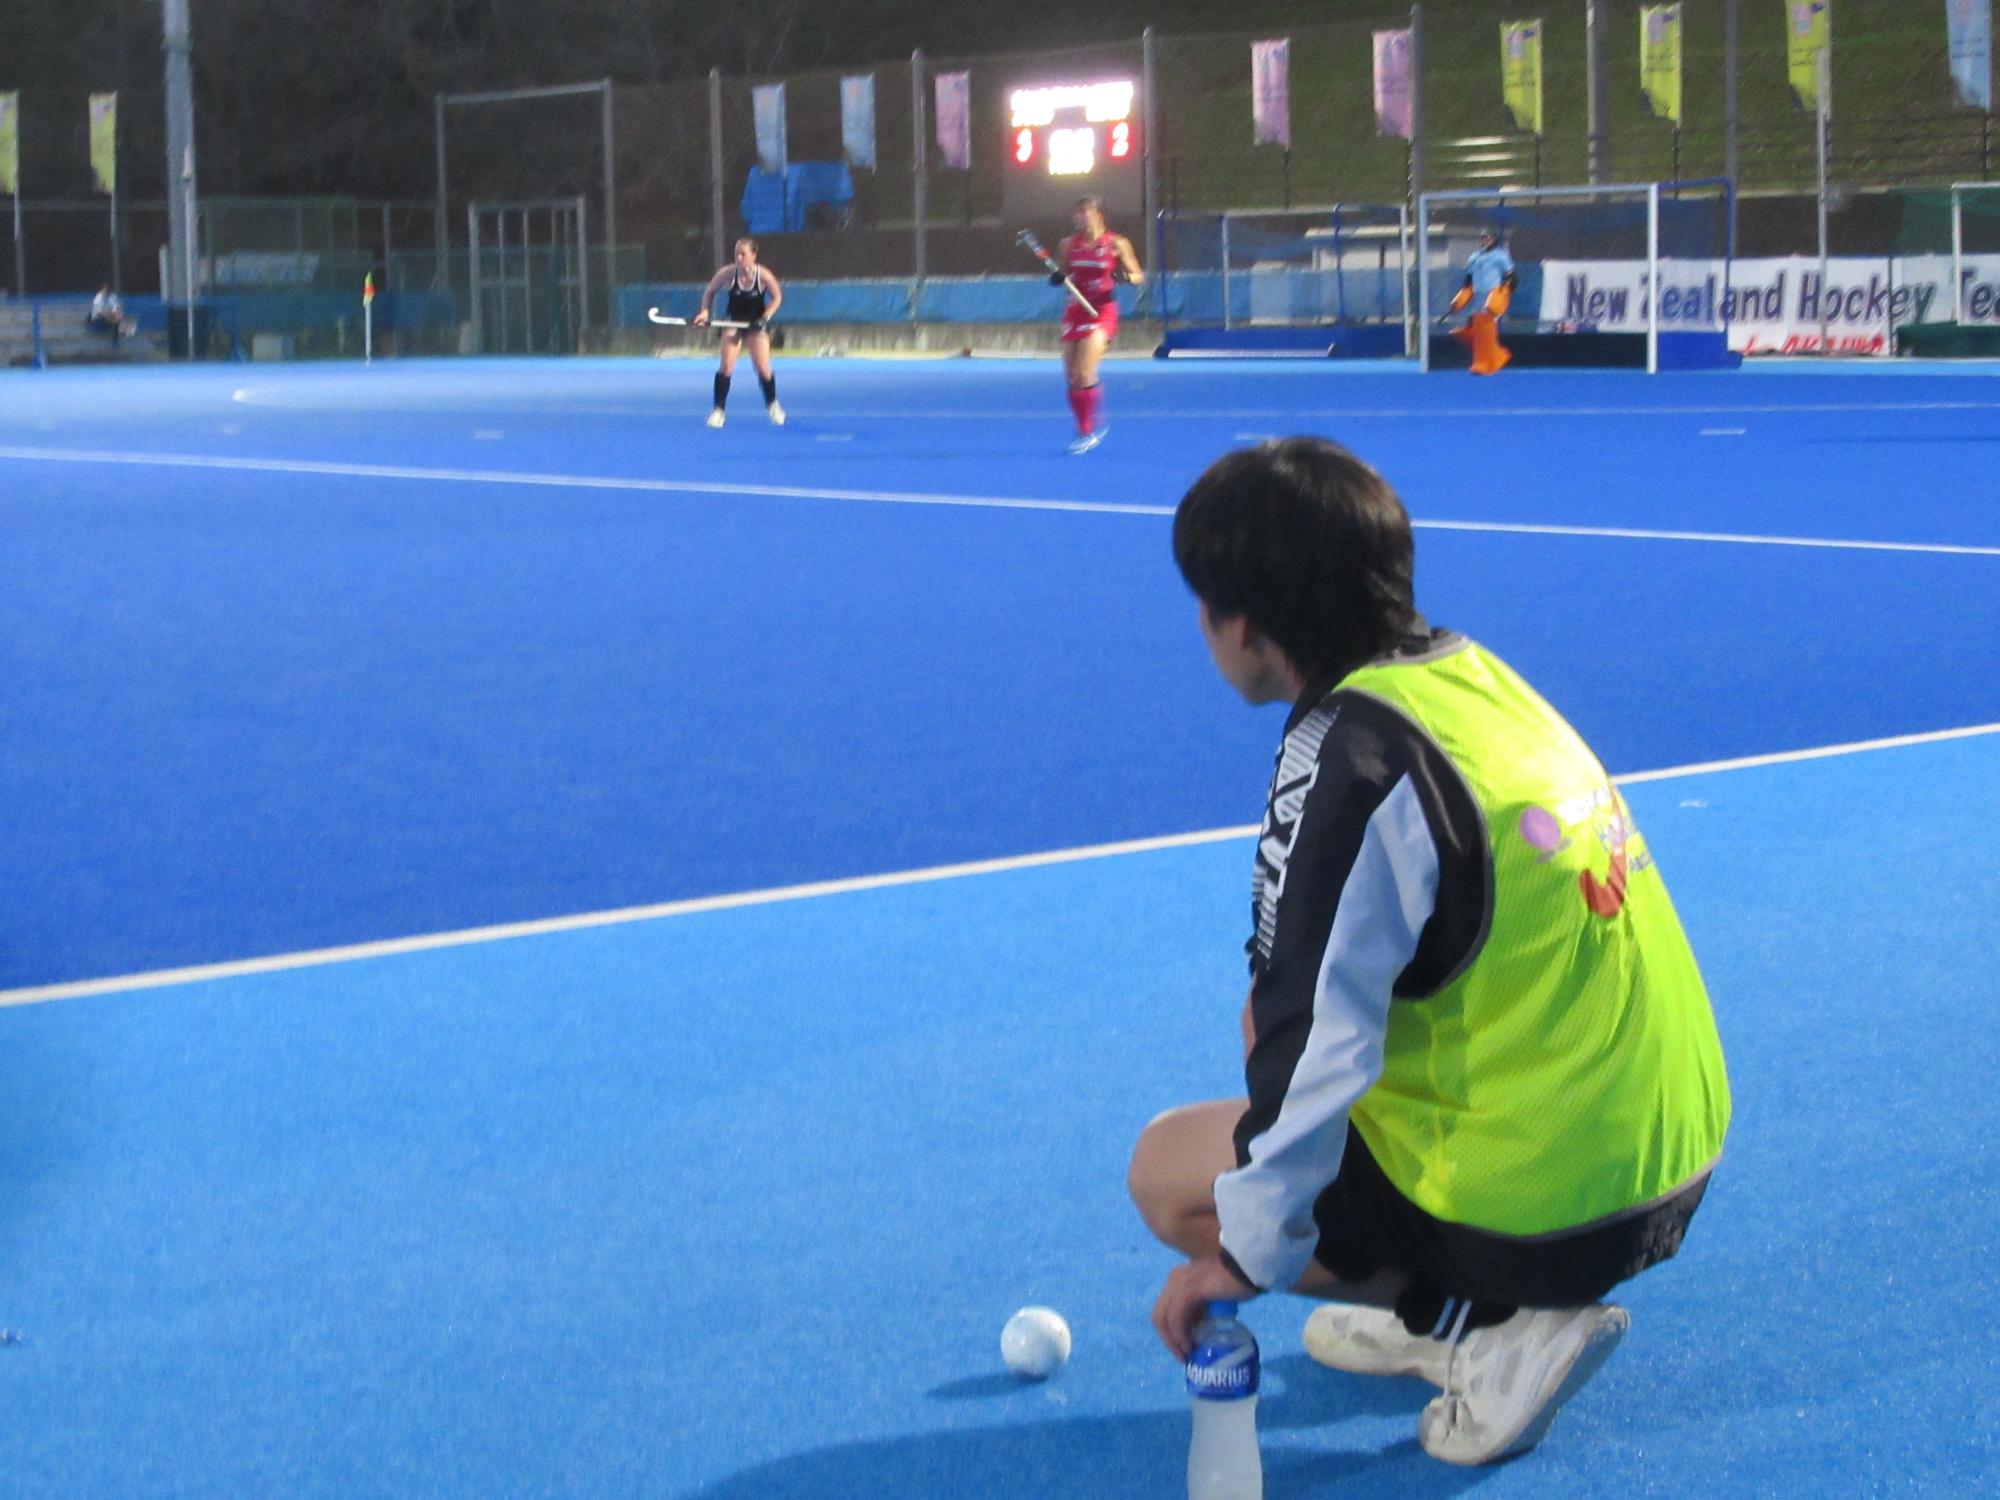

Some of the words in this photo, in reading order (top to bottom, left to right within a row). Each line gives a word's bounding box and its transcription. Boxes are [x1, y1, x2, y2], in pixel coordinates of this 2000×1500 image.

[1110, 121, 1131, 158] 2
[1566, 272, 1628, 322] New
[1798, 270, 1936, 324] Hockey
[1951, 266, 2000, 321] Te
